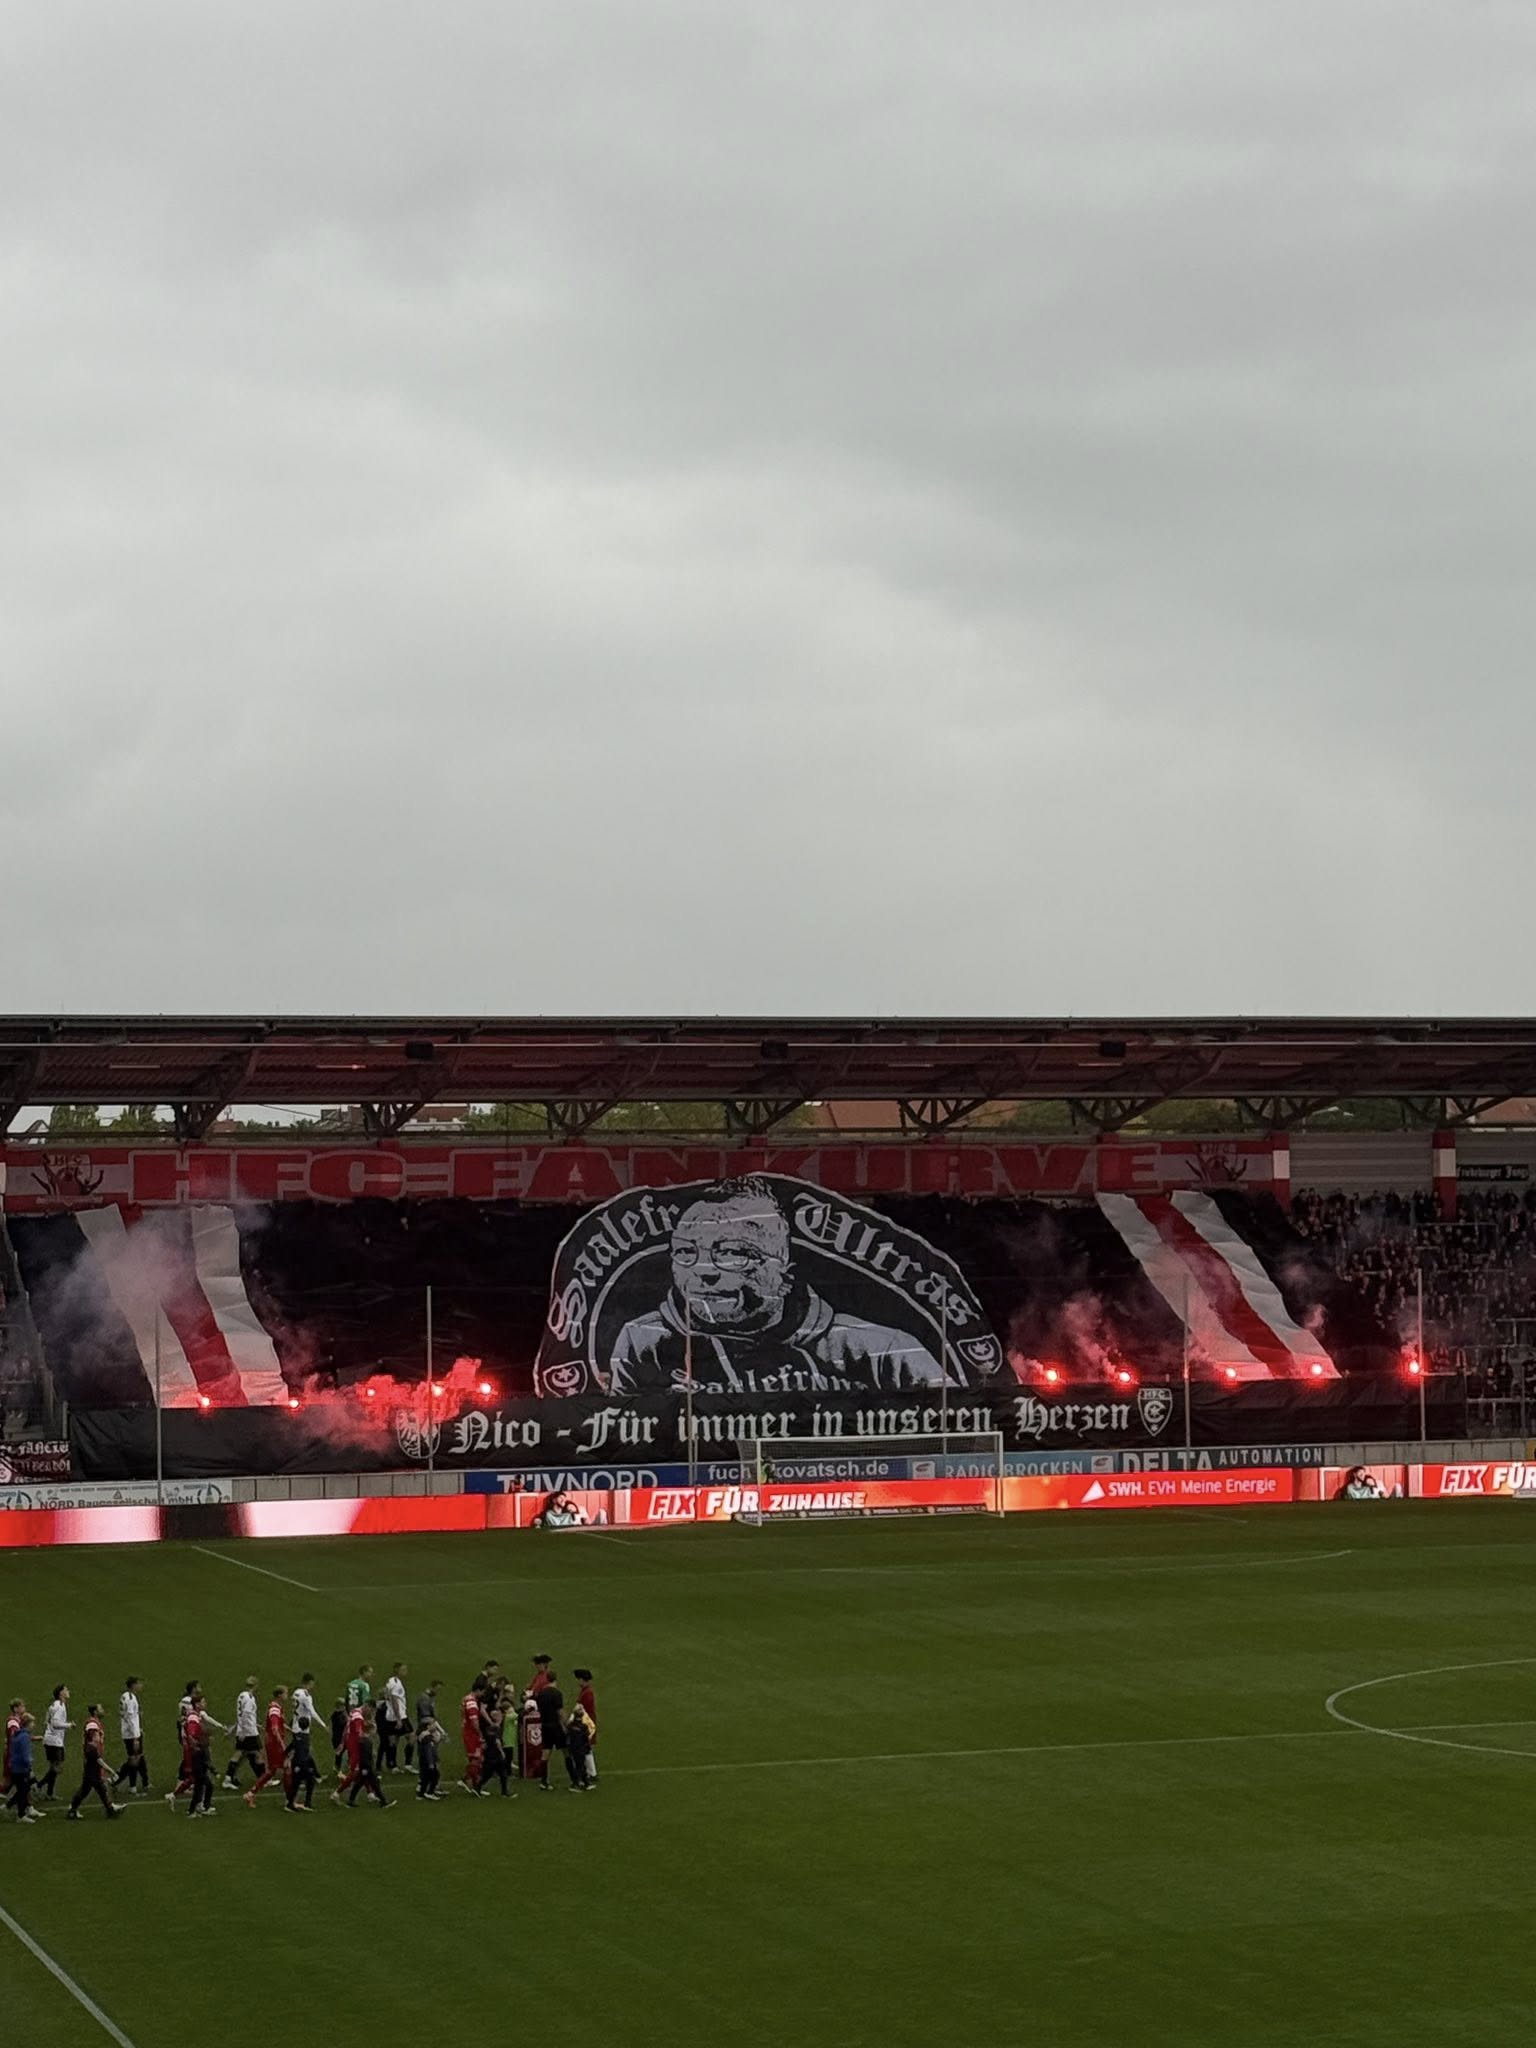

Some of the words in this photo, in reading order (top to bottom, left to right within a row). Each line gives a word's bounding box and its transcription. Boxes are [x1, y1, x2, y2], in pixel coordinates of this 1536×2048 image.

[793, 1192, 980, 1326] Ultras
[448, 1409, 541, 1454] Nico
[576, 1406, 660, 1454] Für
[678, 1407, 796, 1442] immer
[812, 1403, 843, 1437] in
[855, 1404, 992, 1435] unseren
[1013, 1396, 1131, 1440] Herzen
[1123, 1451, 1213, 1473] DELTA
[1219, 1447, 1323, 1466] AUTOMATION
[1108, 1481, 1144, 1496] SWH.
[1149, 1480, 1176, 1495] EVH
[1181, 1479, 1221, 1494] Meine
[1226, 1477, 1277, 1494] Energie
[1441, 1466, 1489, 1493] FIX
[40, 1499, 75, 1510] NORD
[649, 1490, 699, 1519] FIX
[706, 1487, 759, 1514] FÜR
[768, 1491, 868, 1512] ZUHAUSE
